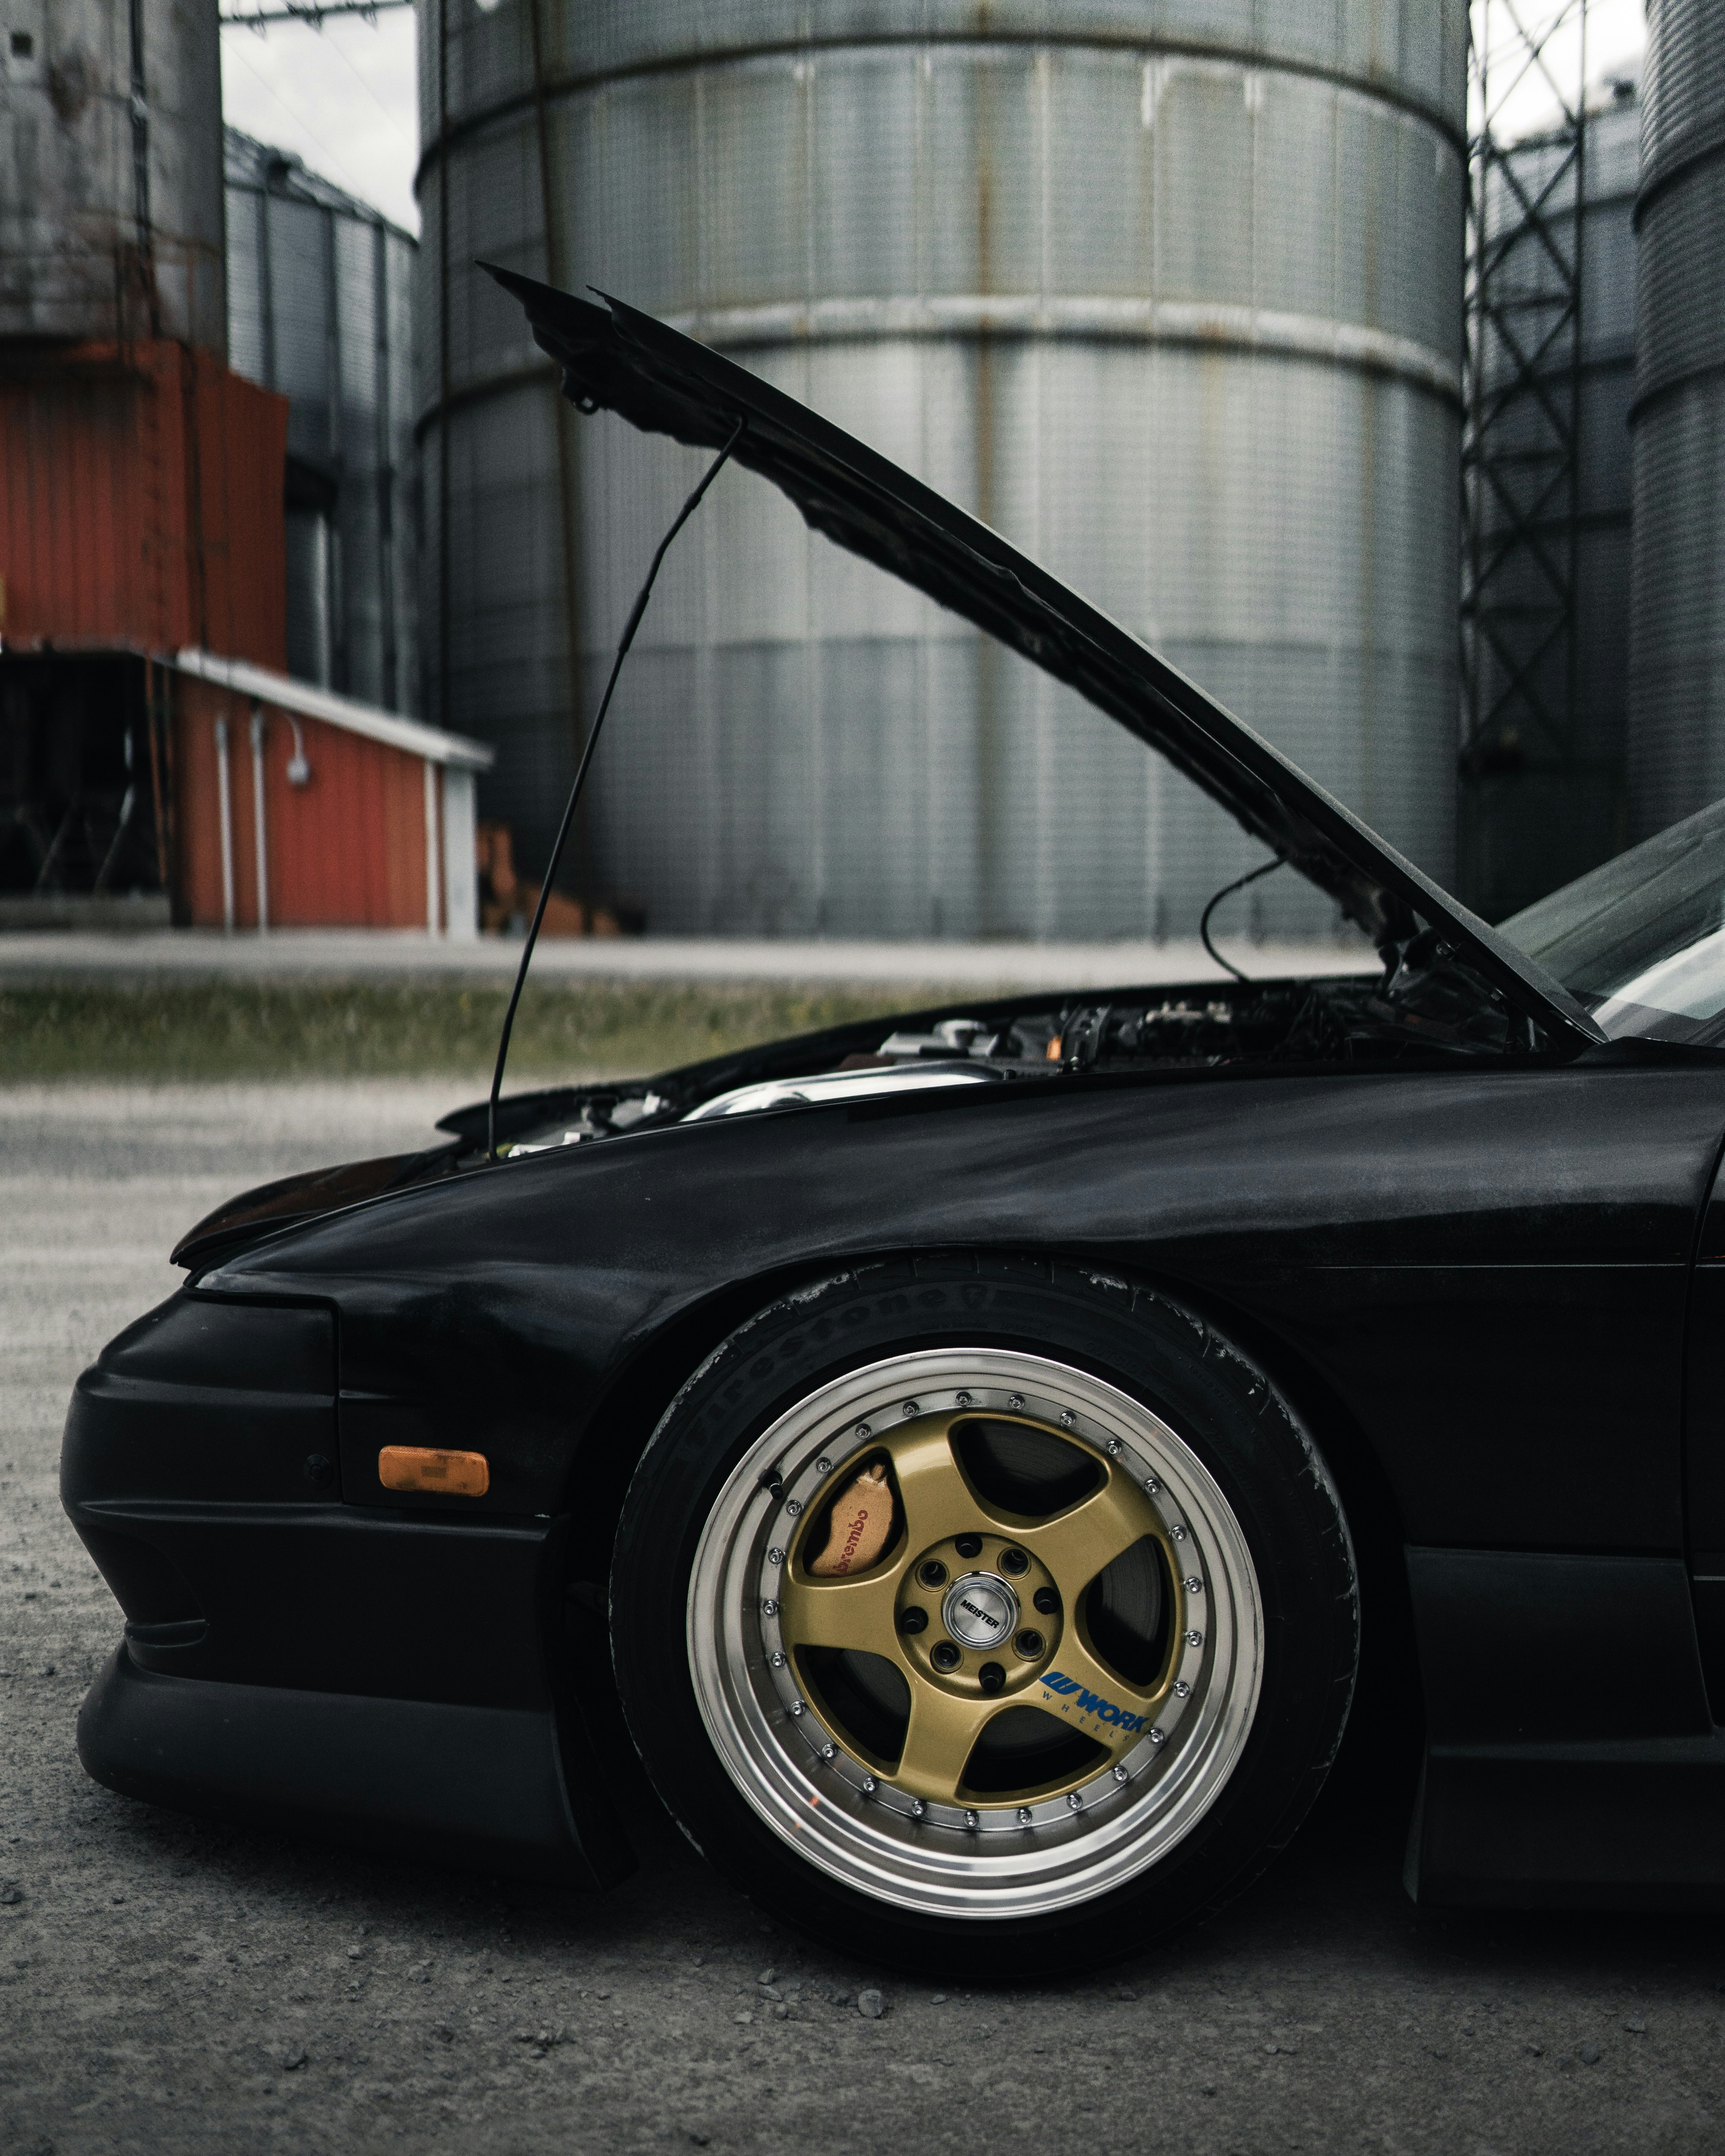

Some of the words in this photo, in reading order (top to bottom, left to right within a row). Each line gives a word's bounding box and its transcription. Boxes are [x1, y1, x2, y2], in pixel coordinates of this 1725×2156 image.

[682, 1288, 946, 1452] Firestone
[833, 1510, 869, 1573] brembo
[960, 1599, 1000, 1629] MEISTER
[1042, 1691, 1129, 1742] WHEELS
[1076, 1688, 1149, 1733] WORK
